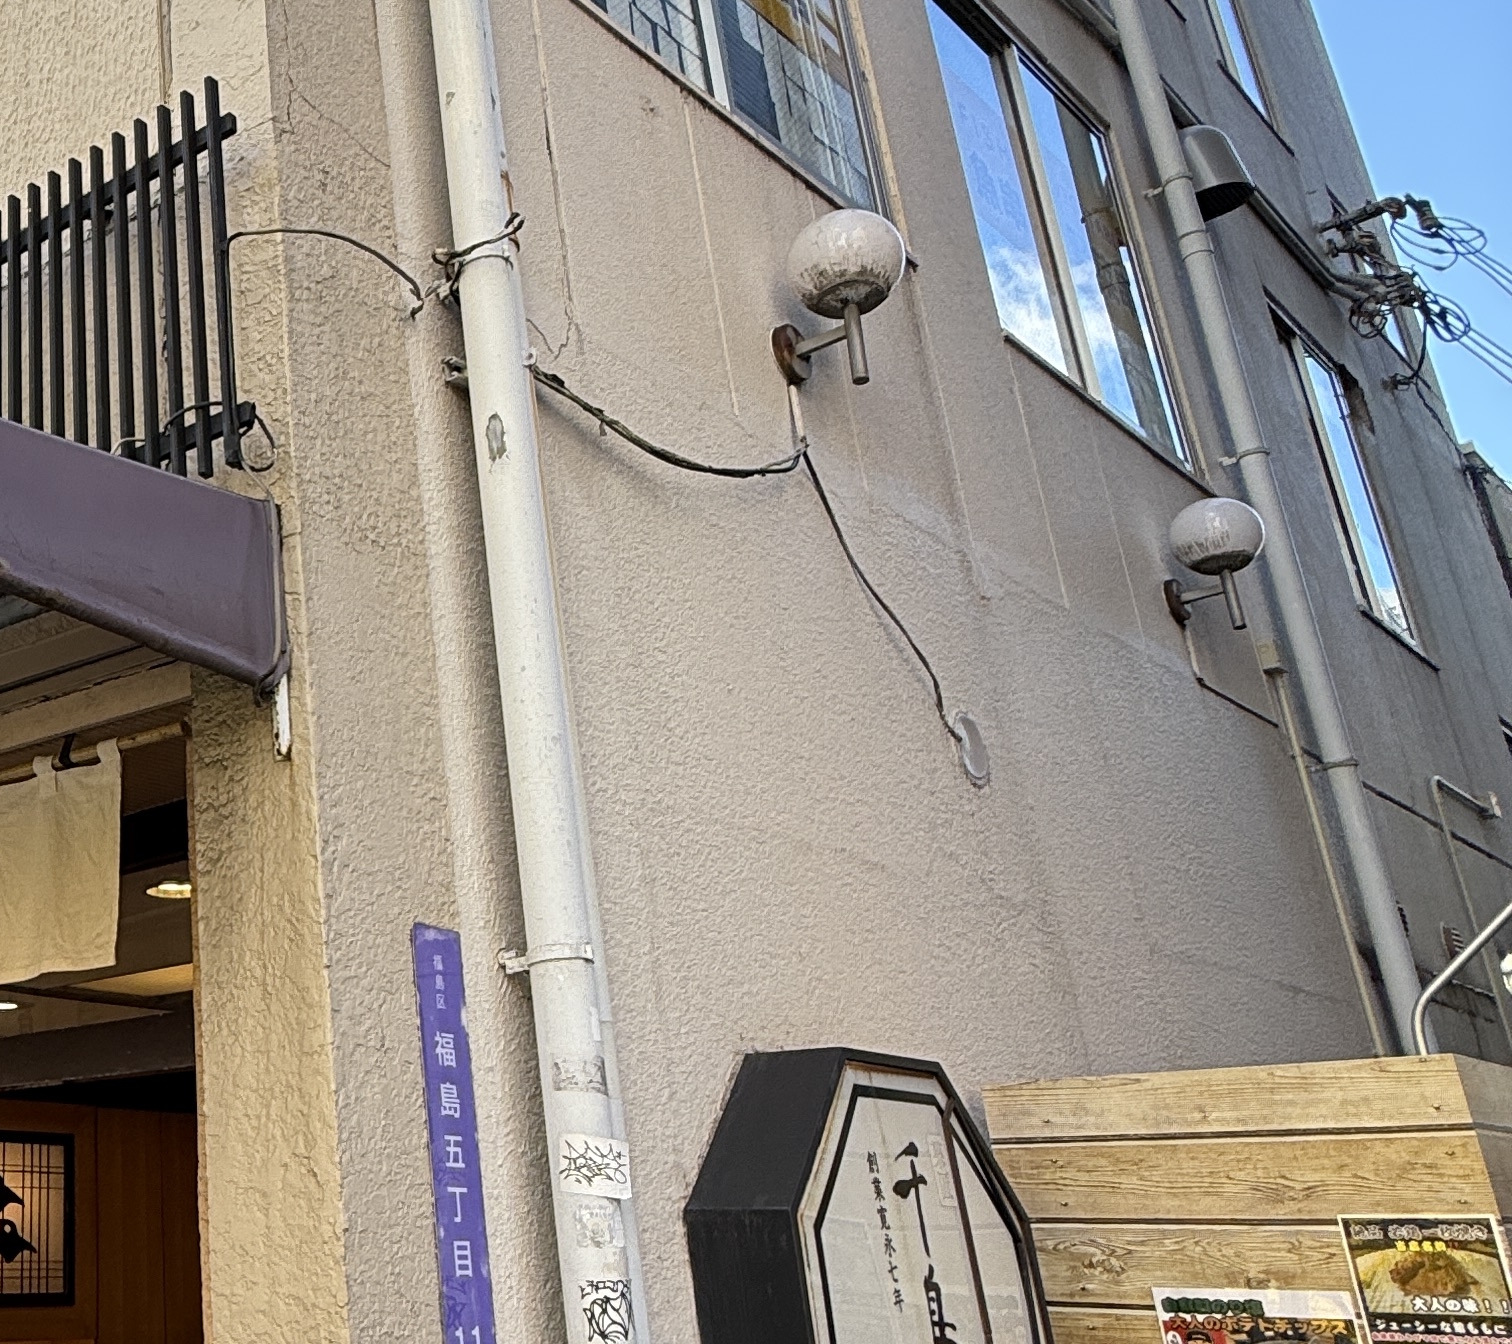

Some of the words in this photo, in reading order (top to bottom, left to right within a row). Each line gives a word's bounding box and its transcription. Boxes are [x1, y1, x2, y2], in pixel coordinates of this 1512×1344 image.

[432, 952, 446, 1010] 福島区
[434, 1030, 474, 1279] 福島五丁目
[865, 1149, 904, 1314] 創業寛永七年
[1169, 1314, 1348, 1336] 大人のポテトチップス
